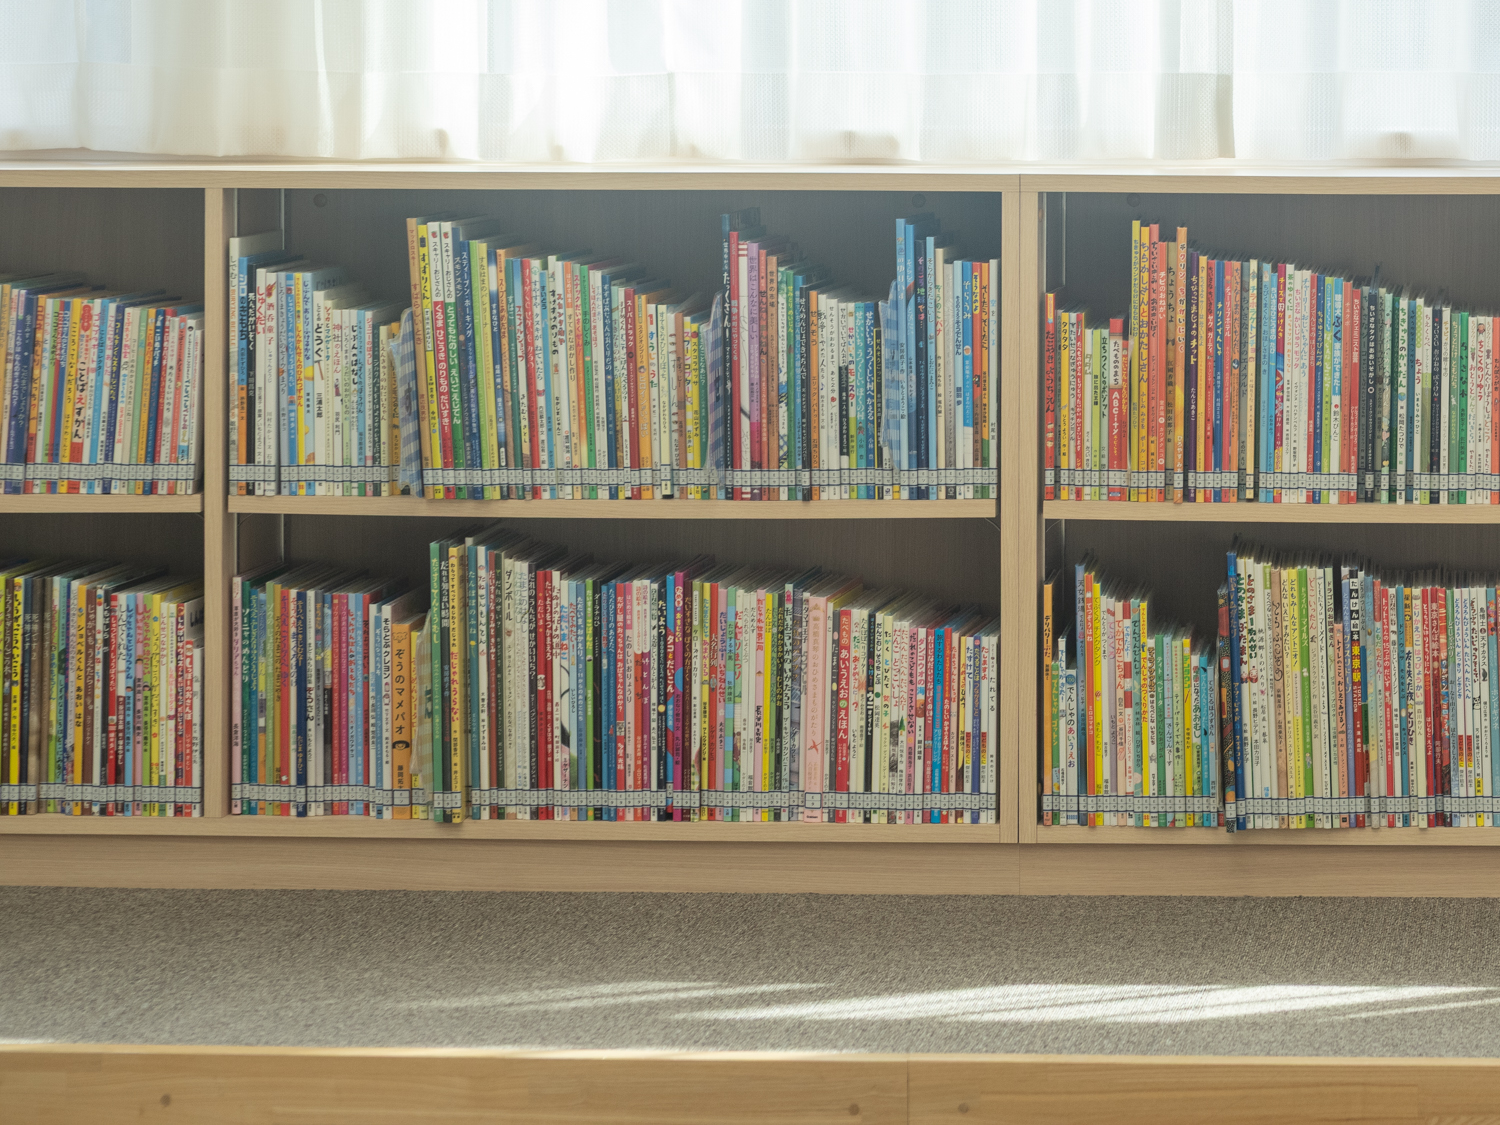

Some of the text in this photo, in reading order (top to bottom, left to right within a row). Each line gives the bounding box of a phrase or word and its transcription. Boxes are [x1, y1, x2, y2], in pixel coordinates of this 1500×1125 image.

[421, 254, 430, 300] すずりくん
[256, 287, 265, 335] しゅくだい
[314, 326, 324, 357] どうぐ
[395, 649, 405, 734] ぞうのマメパオ
[838, 649, 848, 739] あいうえおのえほん
[1067, 688, 1075, 767] でんしゃのあいうえお
